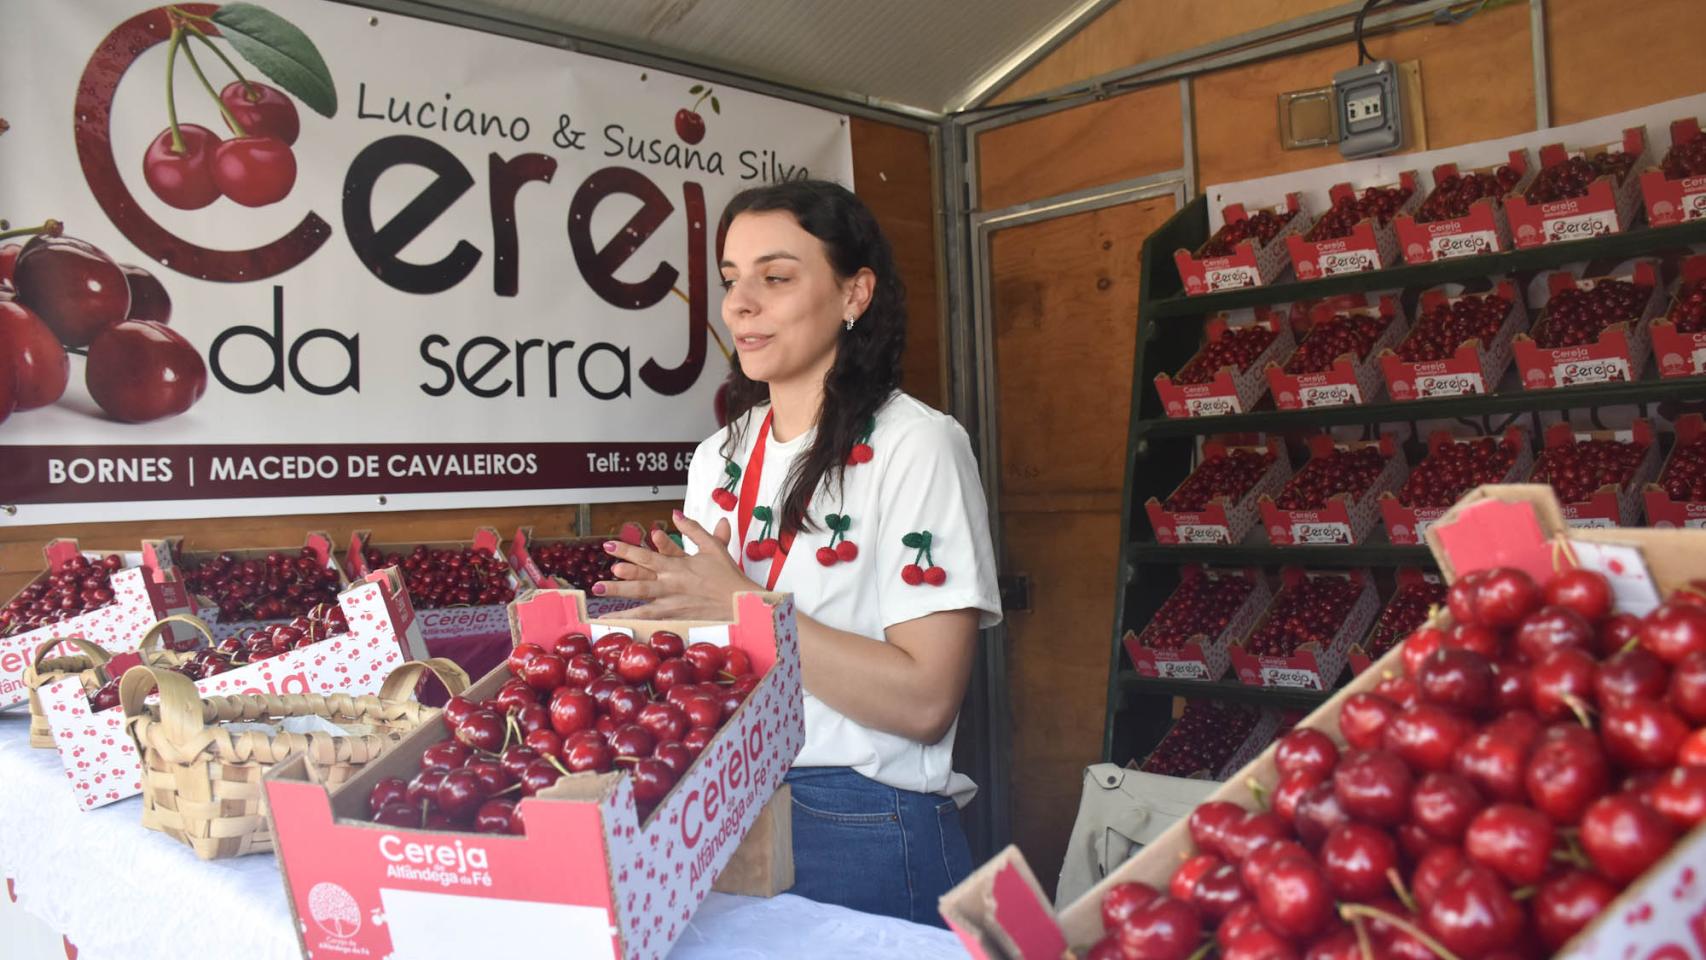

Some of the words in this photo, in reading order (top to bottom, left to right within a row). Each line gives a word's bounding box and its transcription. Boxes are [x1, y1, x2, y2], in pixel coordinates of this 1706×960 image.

[356, 82, 531, 142] Luciano
[552, 113, 587, 150] &
[603, 123, 725, 176] Susana
[74, 2, 728, 396] Cerej
[1552, 216, 1604, 236] Cereja
[1438, 234, 1485, 252] Cereja
[1326, 251, 1368, 270] Cereja
[1210, 269, 1249, 285] Cereja
[208, 284, 360, 396] da
[418, 333, 632, 401] serra
[1564, 359, 1617, 379] Cereja
[1307, 386, 1349, 404] Cereja
[1423, 375, 1469, 394] Cereja
[48, 457, 173, 484] BORNES
[209, 455, 339, 481] MACEDO
[347, 454, 380, 477] DE
[387, 453, 538, 477] CAVALEIROS
[587, 452, 631, 473] Telf.:
[635, 451, 669, 472] 938
[423, 610, 489, 628] Cereja
[681, 719, 764, 849] Cereja
[379, 834, 489, 873] Cereja
[688, 799, 746, 891] Alfândega
[386, 863, 459, 887] Alfândega
[472, 871, 493, 887] Fé
